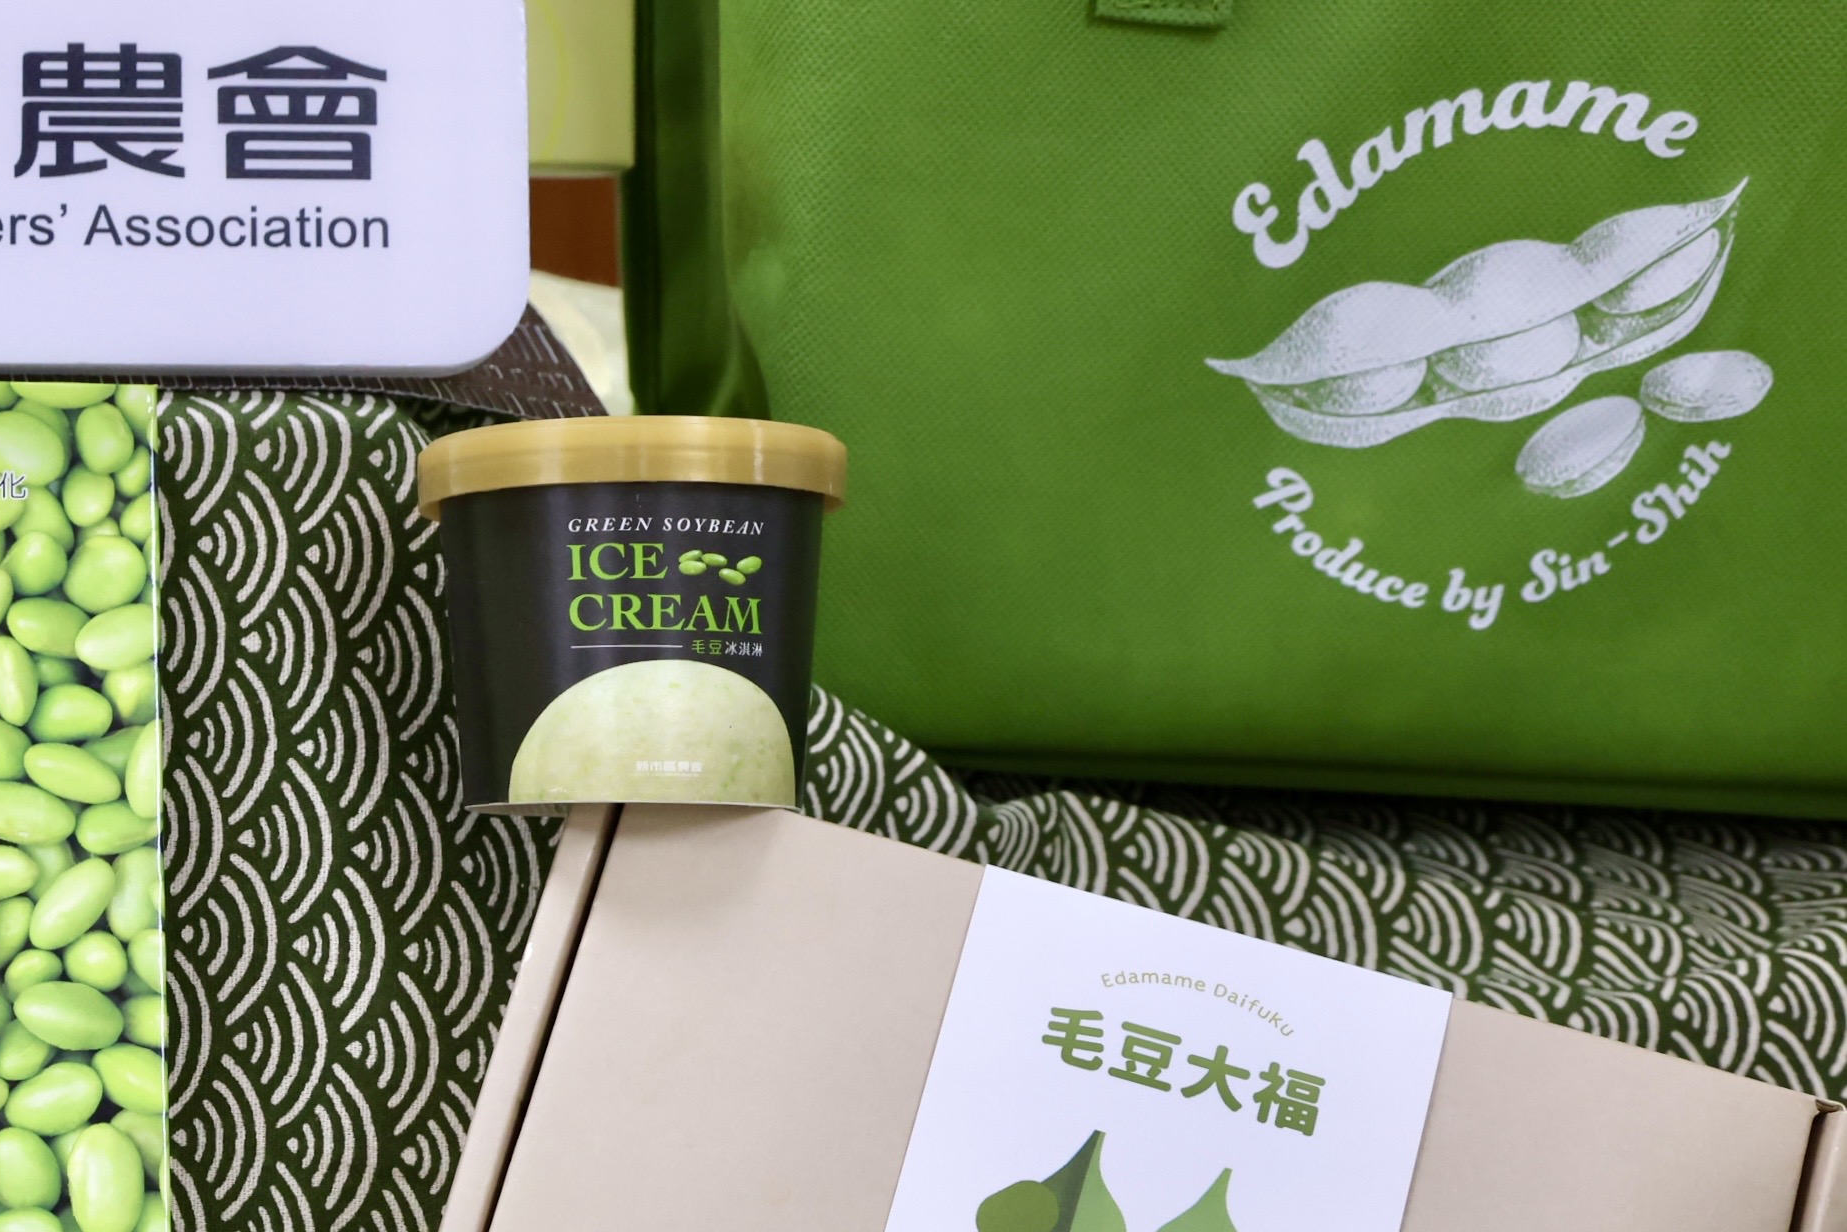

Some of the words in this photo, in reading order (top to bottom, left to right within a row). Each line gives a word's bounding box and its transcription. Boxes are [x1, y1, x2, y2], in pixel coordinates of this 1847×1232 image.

[1233, 79, 1698, 269] Edamame
[83, 203, 390, 249] Association
[567, 516, 654, 534] GREEN
[662, 517, 765, 536] SOYBEAN
[1254, 467, 1429, 607] Produce
[1442, 568, 1504, 631] by
[567, 542, 668, 581] ICE
[569, 593, 763, 635] CREAM
[691, 639, 764, 657] 毛豆冰淇淋
[1101, 970, 1207, 993] Edamame
[1213, 983, 1295, 1037] Daifuku
[1042, 1006, 1326, 1137] 毛豆大福
